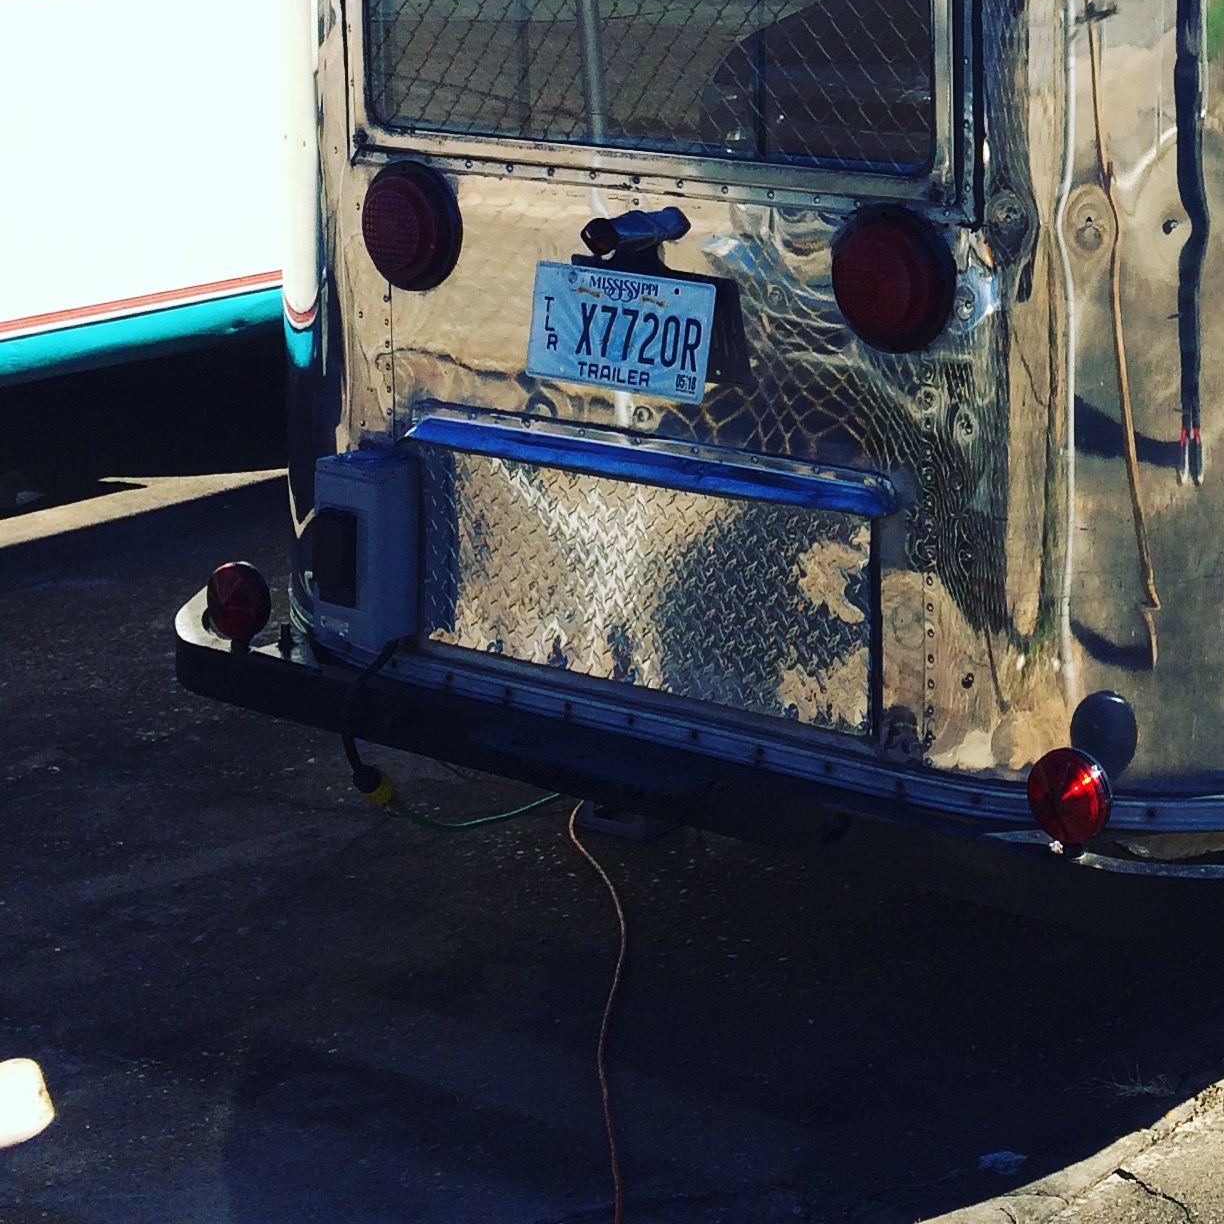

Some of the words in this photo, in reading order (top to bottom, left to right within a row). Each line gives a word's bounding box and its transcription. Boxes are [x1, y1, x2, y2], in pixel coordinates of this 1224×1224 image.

[589, 275, 659, 303] MISSISSIPPI
[575, 302, 702, 372] X7720R
[577, 361, 650, 387] TRAILER
